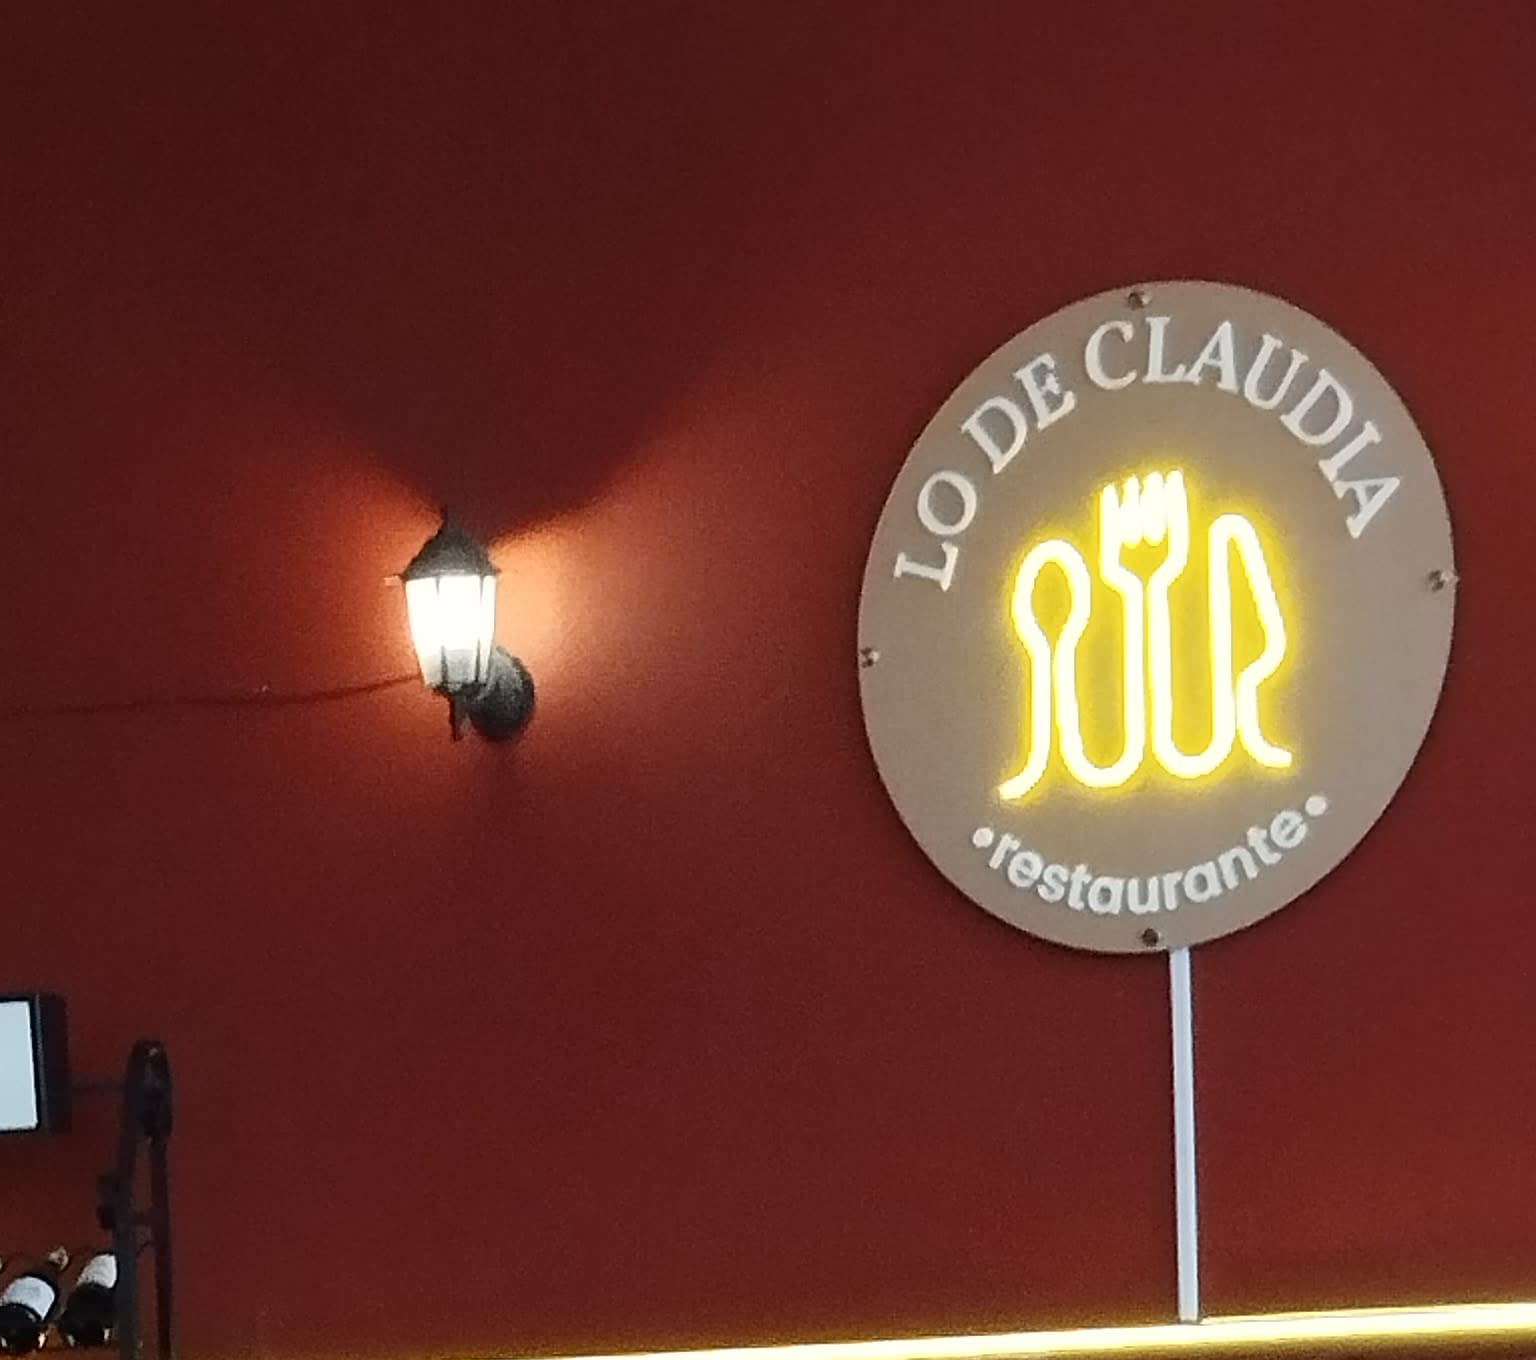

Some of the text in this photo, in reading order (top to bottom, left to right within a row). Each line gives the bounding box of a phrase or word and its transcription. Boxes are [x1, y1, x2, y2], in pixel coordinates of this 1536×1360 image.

[893, 316, 1402, 592] LO DE CLAUDIA
[987, 808, 1309, 916] restaurante
